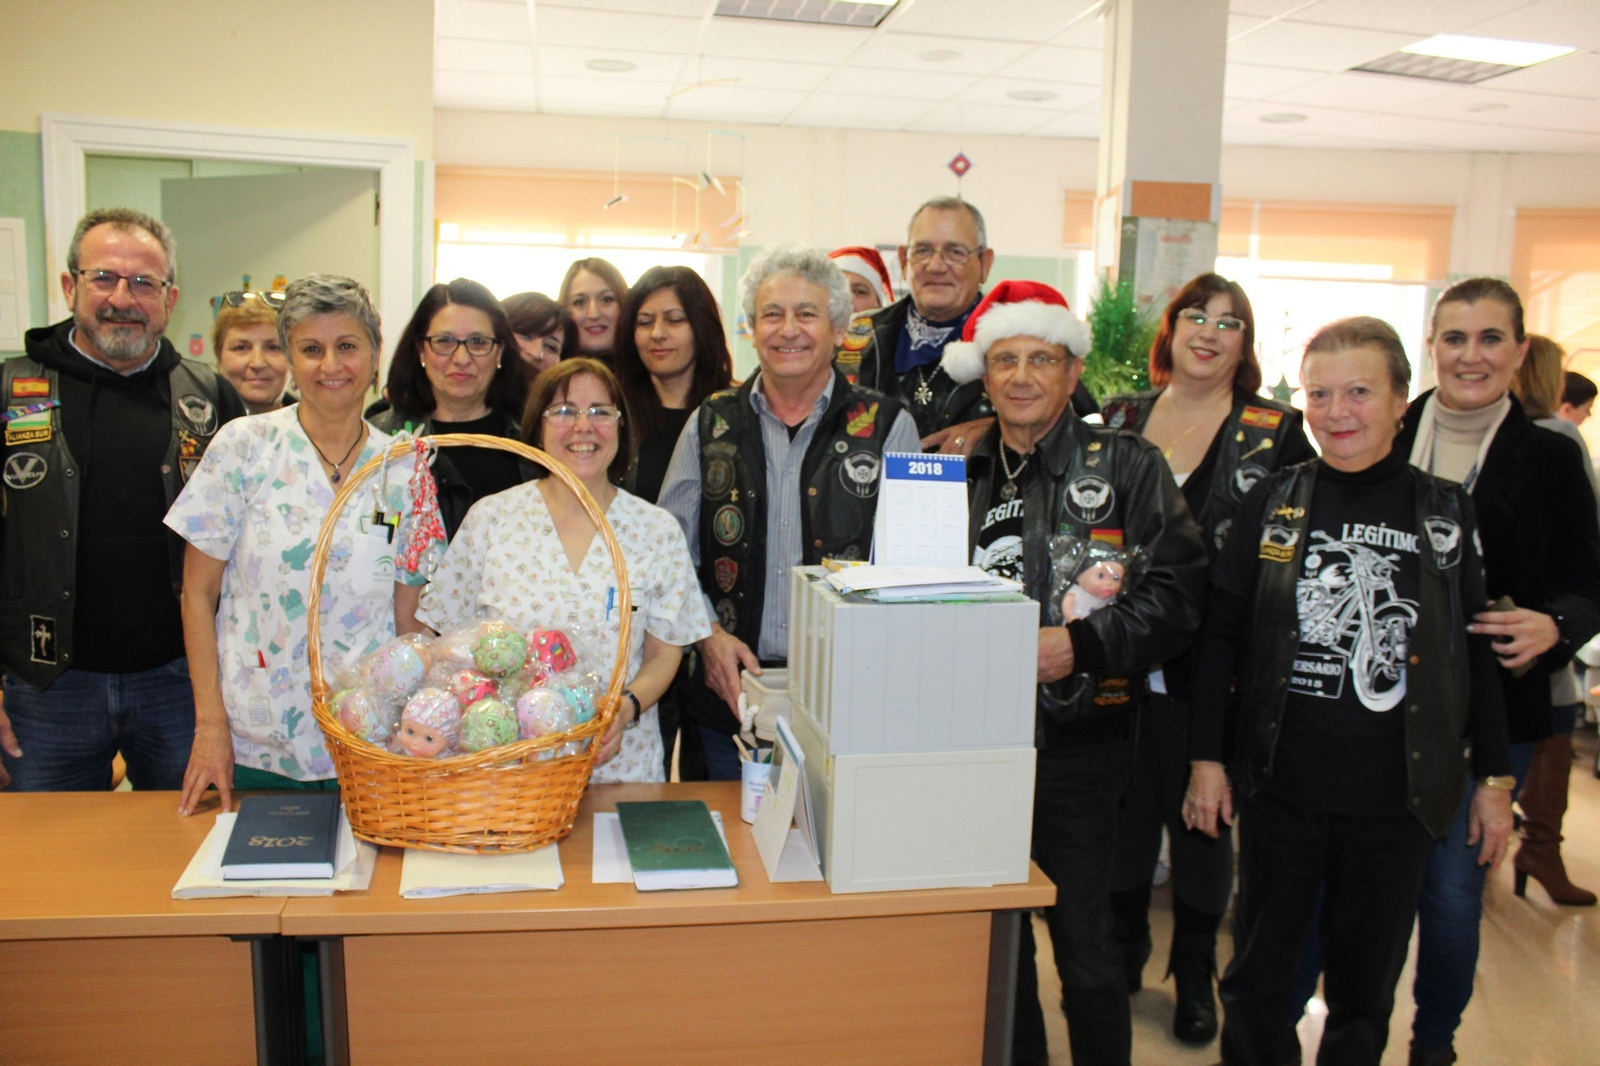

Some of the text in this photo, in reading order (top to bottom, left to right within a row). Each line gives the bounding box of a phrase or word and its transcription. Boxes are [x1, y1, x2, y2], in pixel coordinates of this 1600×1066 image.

[35, 429, 48, 438] SUR
[908, 461, 943, 476] 2018
[1293, 660, 1342, 676] ERSARIO
[248, 836, 315, 848] 2018
